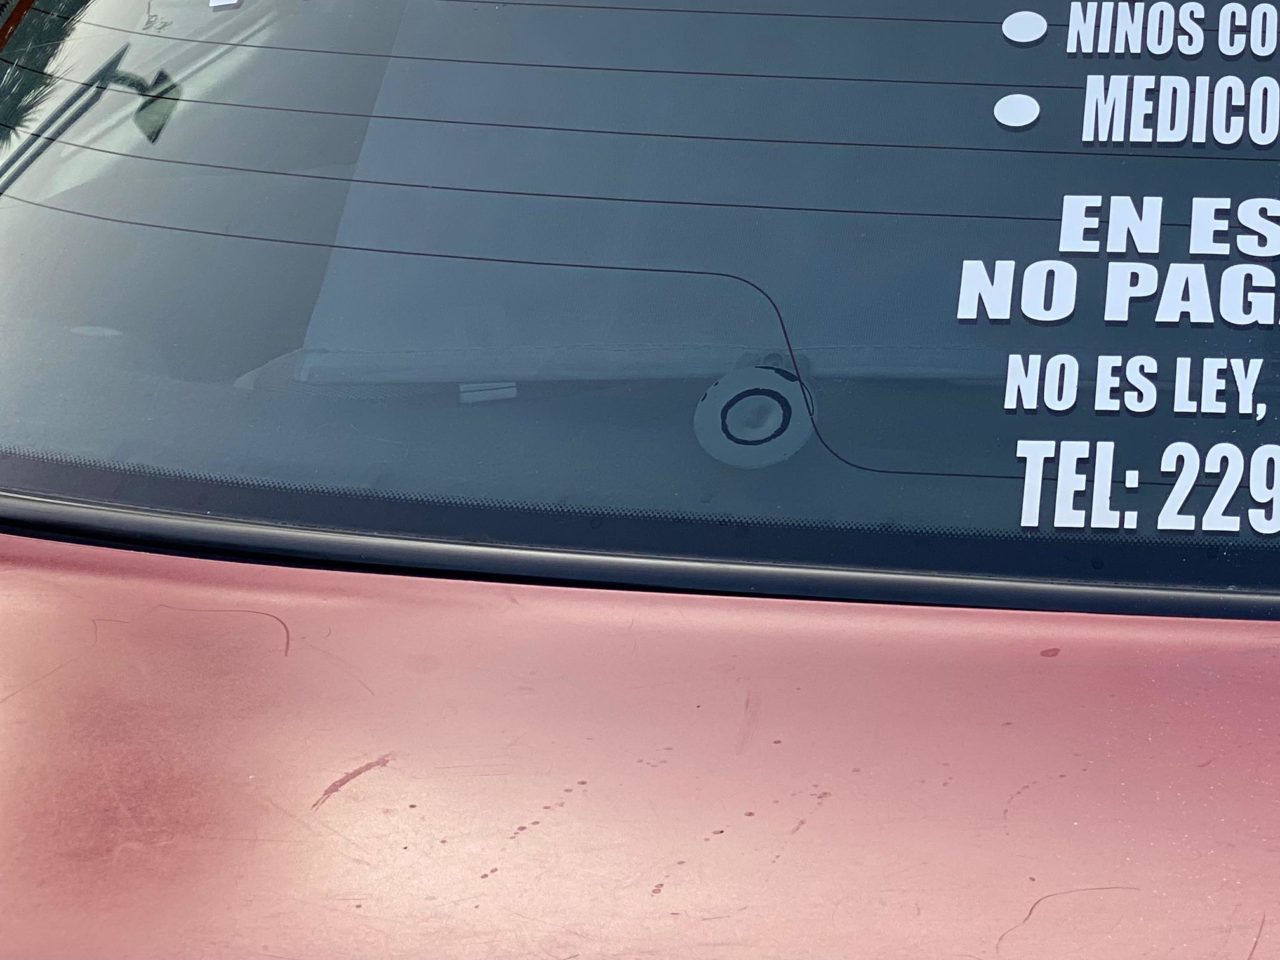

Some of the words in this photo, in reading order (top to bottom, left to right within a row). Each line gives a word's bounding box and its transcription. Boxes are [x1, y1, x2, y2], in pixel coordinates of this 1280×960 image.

[1058, 194, 1163, 254] EN
[956, 259, 1078, 322] NO
[1003, 353, 1079, 411] NO
[1094, 355, 1158, 413] ES
[1173, 357, 1267, 421] LEY,
[1016, 439, 1139, 529] TEL:
